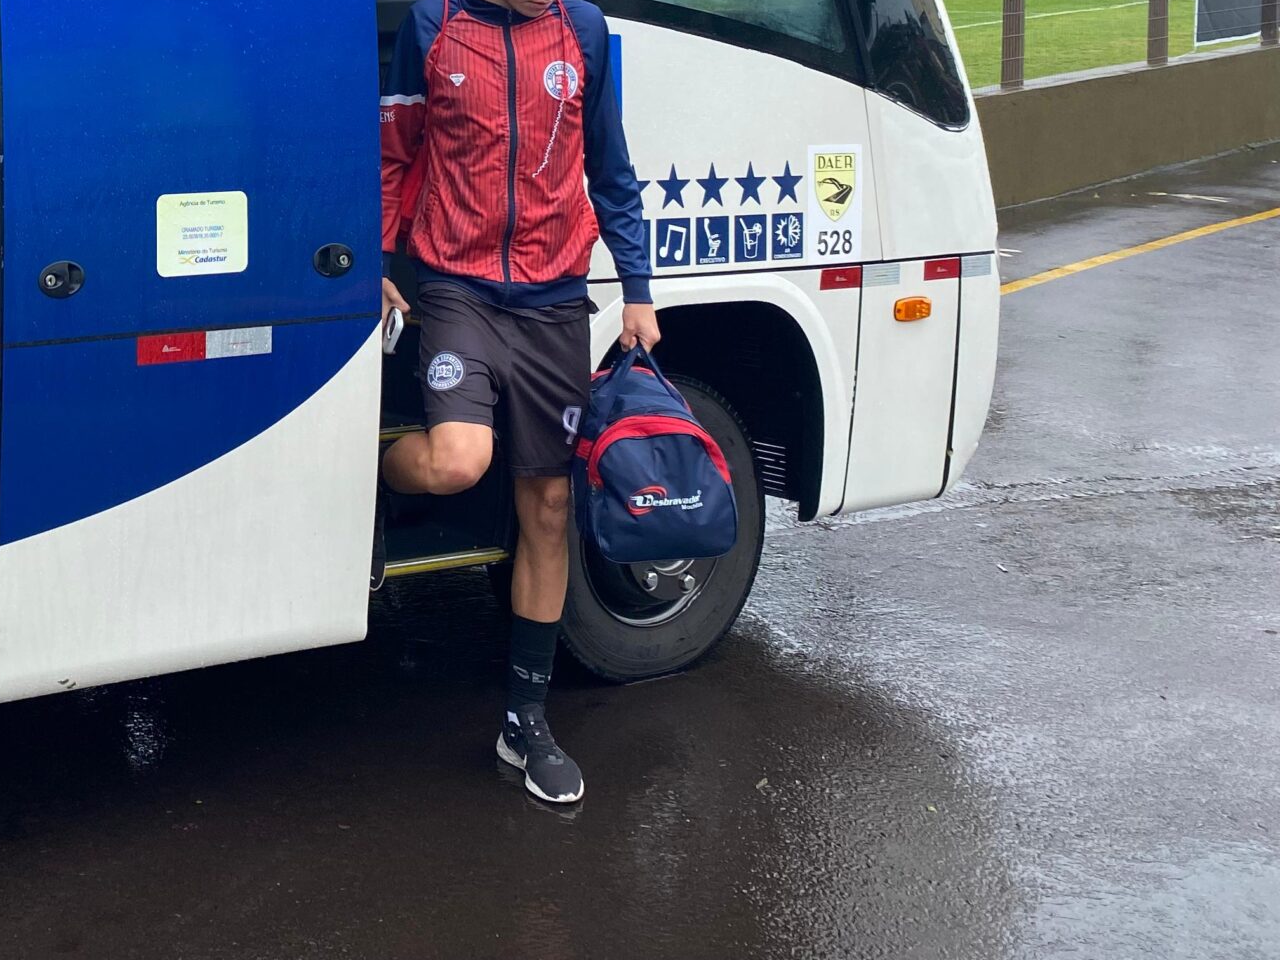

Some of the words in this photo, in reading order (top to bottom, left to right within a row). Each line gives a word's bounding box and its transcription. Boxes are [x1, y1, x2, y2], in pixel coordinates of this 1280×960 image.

[817, 155, 853, 169] DAER
[817, 229, 853, 256] 528
[194, 255, 227, 264] Cadastur
